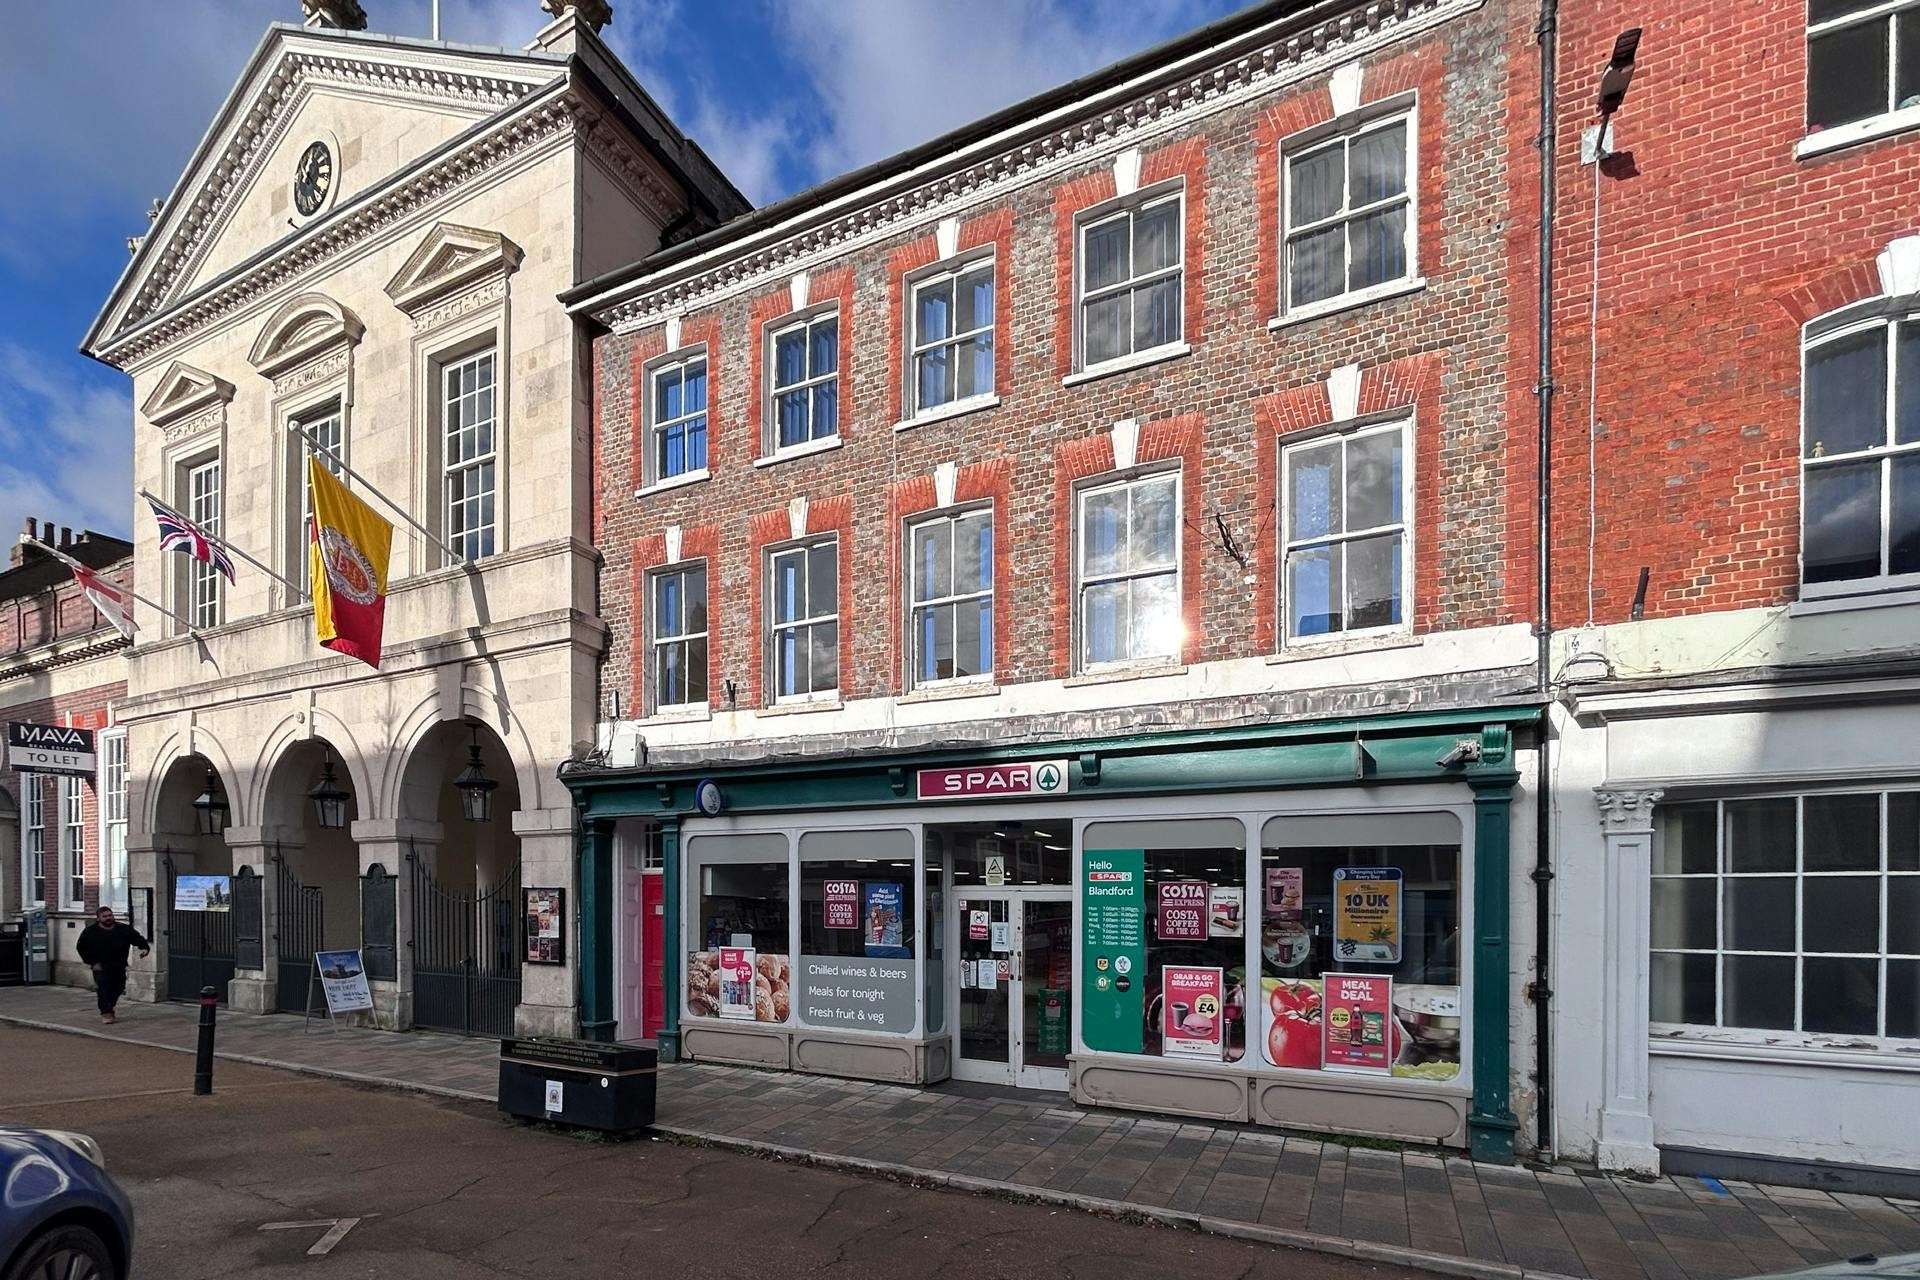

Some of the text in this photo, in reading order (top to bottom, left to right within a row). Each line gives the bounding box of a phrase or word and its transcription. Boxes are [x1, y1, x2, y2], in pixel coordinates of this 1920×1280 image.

[20, 726, 84, 745] MAVA
[27, 752, 80, 765] TO LET
[944, 770, 1028, 791] SPAR
[1089, 861, 1112, 870] Hello
[826, 883, 856, 894] COSTA
[1088, 886, 1134, 896] Blandford
[1161, 885, 1204, 898] COSTA
[1345, 895, 1389, 906] 10 UK
[1166, 910, 1199, 920] COSTA
[809, 965, 907, 979] Chilled wines & beers
[1342, 980, 1372, 990] MEAL
[809, 986, 885, 1002] Meals for tonight
[1341, 990, 1374, 1001] DEAL
[1198, 1003, 1215, 1013] £4
[809, 1007, 884, 1024] Fresh fruit & veg
